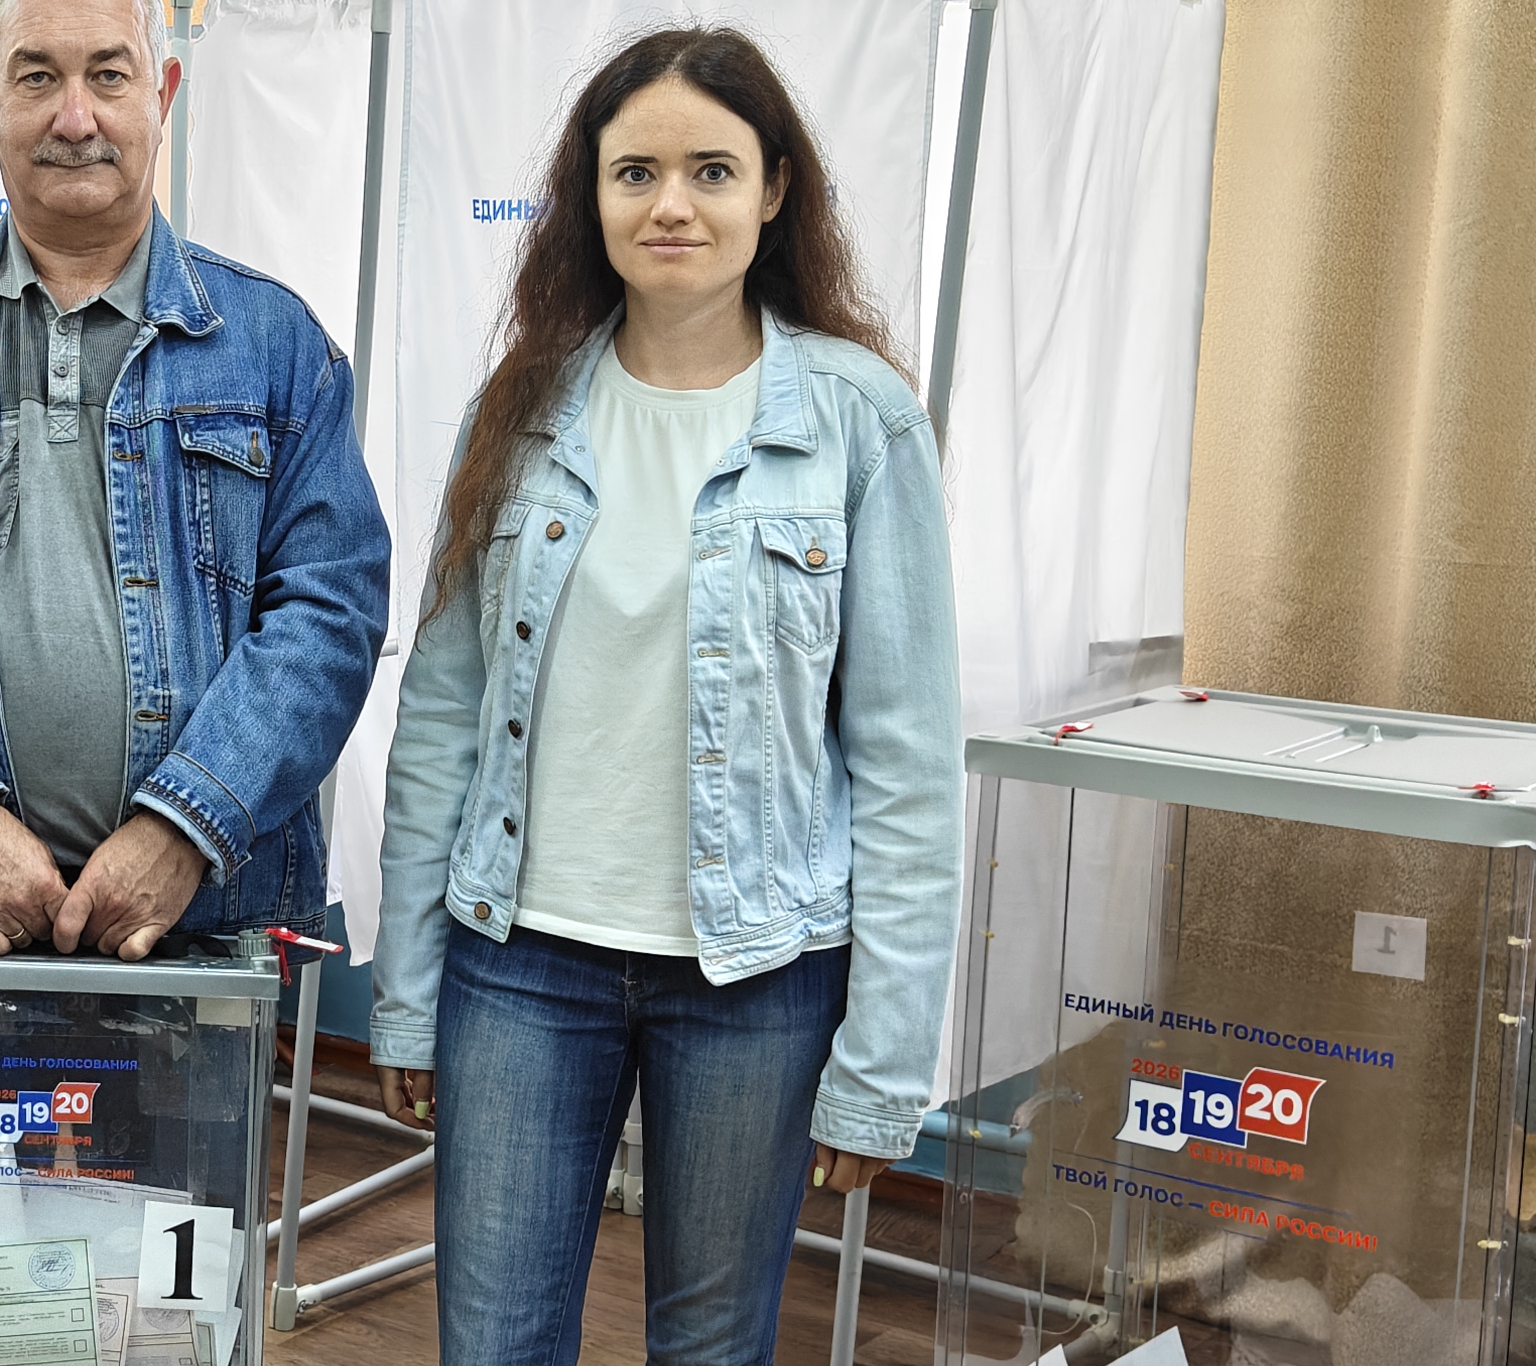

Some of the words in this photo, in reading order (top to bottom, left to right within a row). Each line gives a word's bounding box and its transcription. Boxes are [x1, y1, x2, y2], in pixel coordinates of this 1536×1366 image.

[1064, 993, 1155, 1023] ЕДИНЫЙ
[1159, 1010, 1217, 1034] ДЕНЬ
[1222, 1022, 1395, 1069] ГОЛОСОВАНИЯ
[2, 1057, 37, 1069] ДЕНЬ
[39, 1058, 138, 1071] ГОЛОСОВАНИЯ
[1131, 1057, 1181, 1081] 2026
[22, 1101, 49, 1124] 19
[55, 1092, 88, 1114] 20
[1134, 1099, 1177, 1136] 18
[1188, 1090, 1234, 1128] 19
[1244, 1083, 1303, 1125] 20
[24, 1135, 92, 1147] СЕНТЯБРЯ
[38, 1166, 73, 1178] СИЛА
[77, 1169, 135, 1180] РОССИИ!
[1188, 1142, 1305, 1181] СЕНТЯБРЯ
[1053, 1163, 1108, 1190] ТВОЙ
[1113, 1178, 1183, 1207] ГОЛОС
[1209, 1200, 1270, 1228] СИЛА
[1276, 1214, 1378, 1252] РОССИИ!
[161, 1219, 203, 1300] 1
